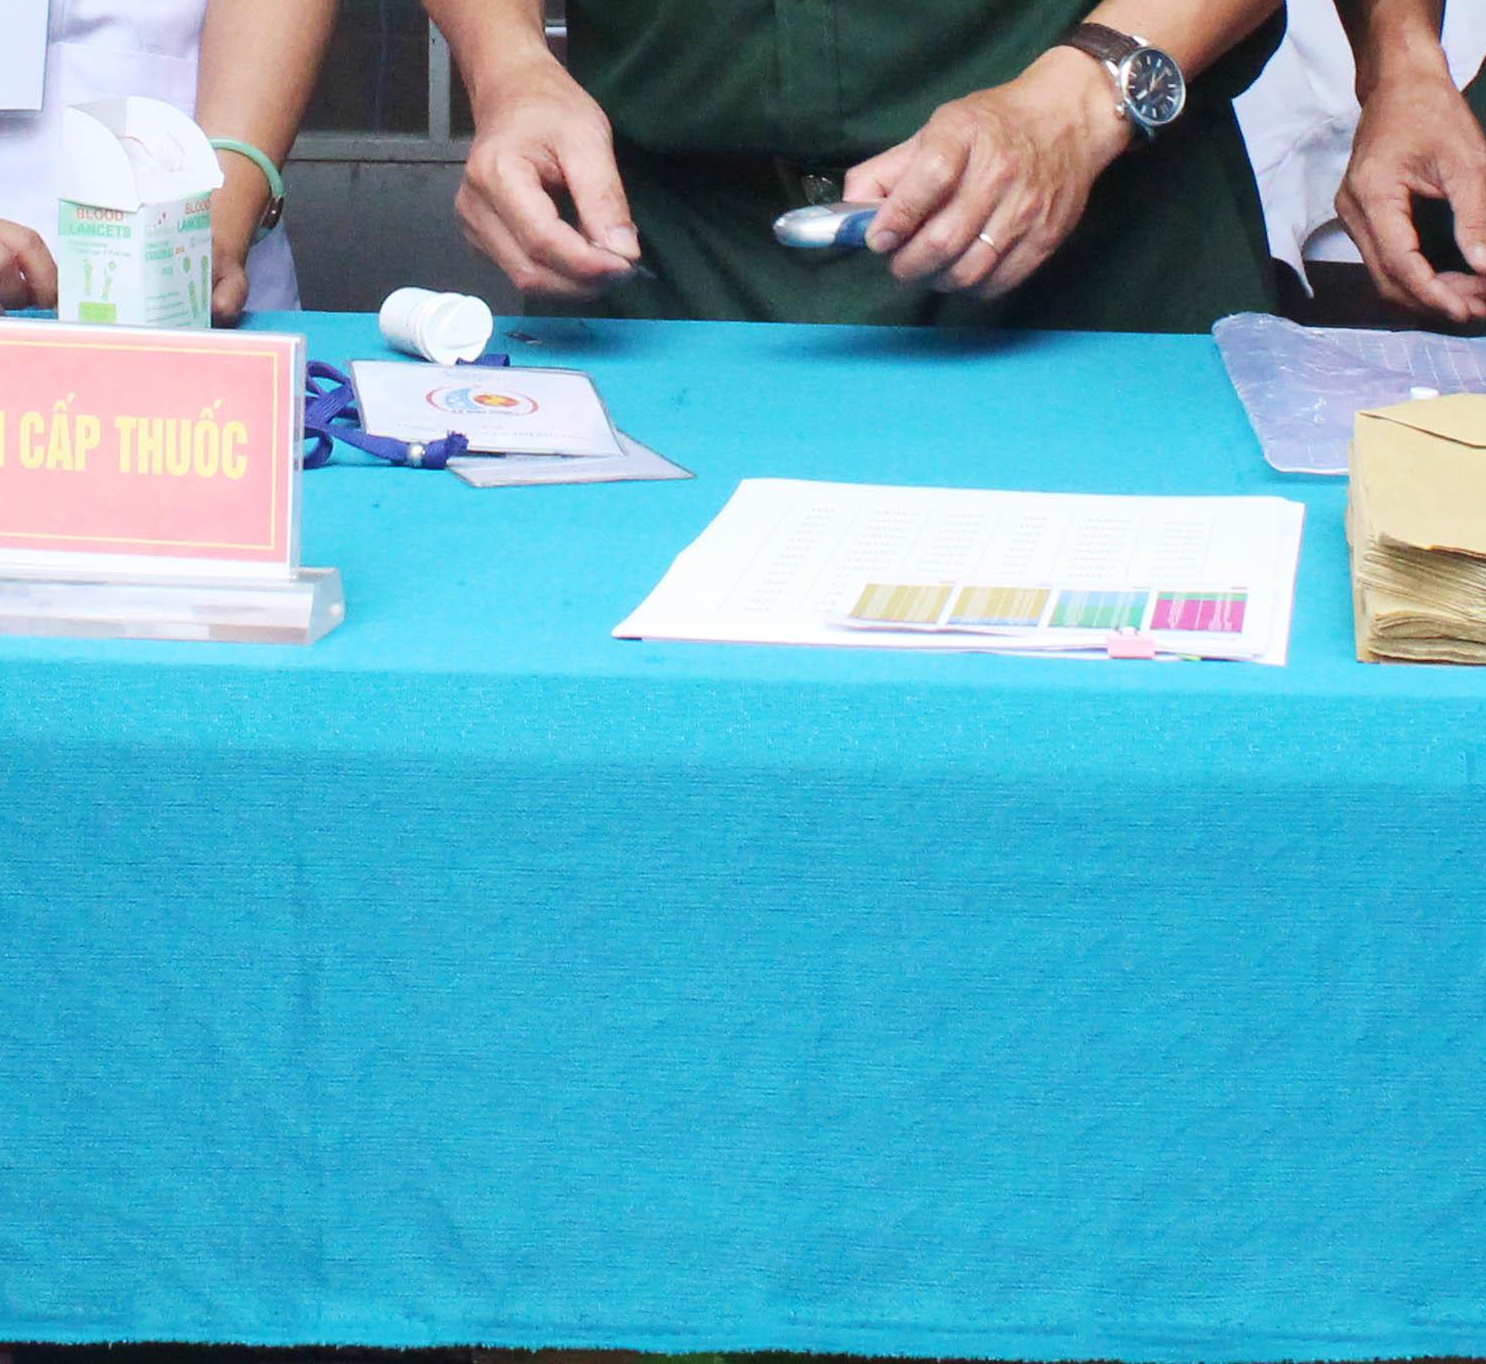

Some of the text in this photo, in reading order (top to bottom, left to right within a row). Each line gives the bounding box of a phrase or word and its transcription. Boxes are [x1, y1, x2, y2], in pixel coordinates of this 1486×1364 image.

[77, 207, 124, 221] BLOOD
[68, 223, 131, 237] LANCETS
[19, 392, 101, 471] CẤP
[115, 399, 249, 479] THUỐC
